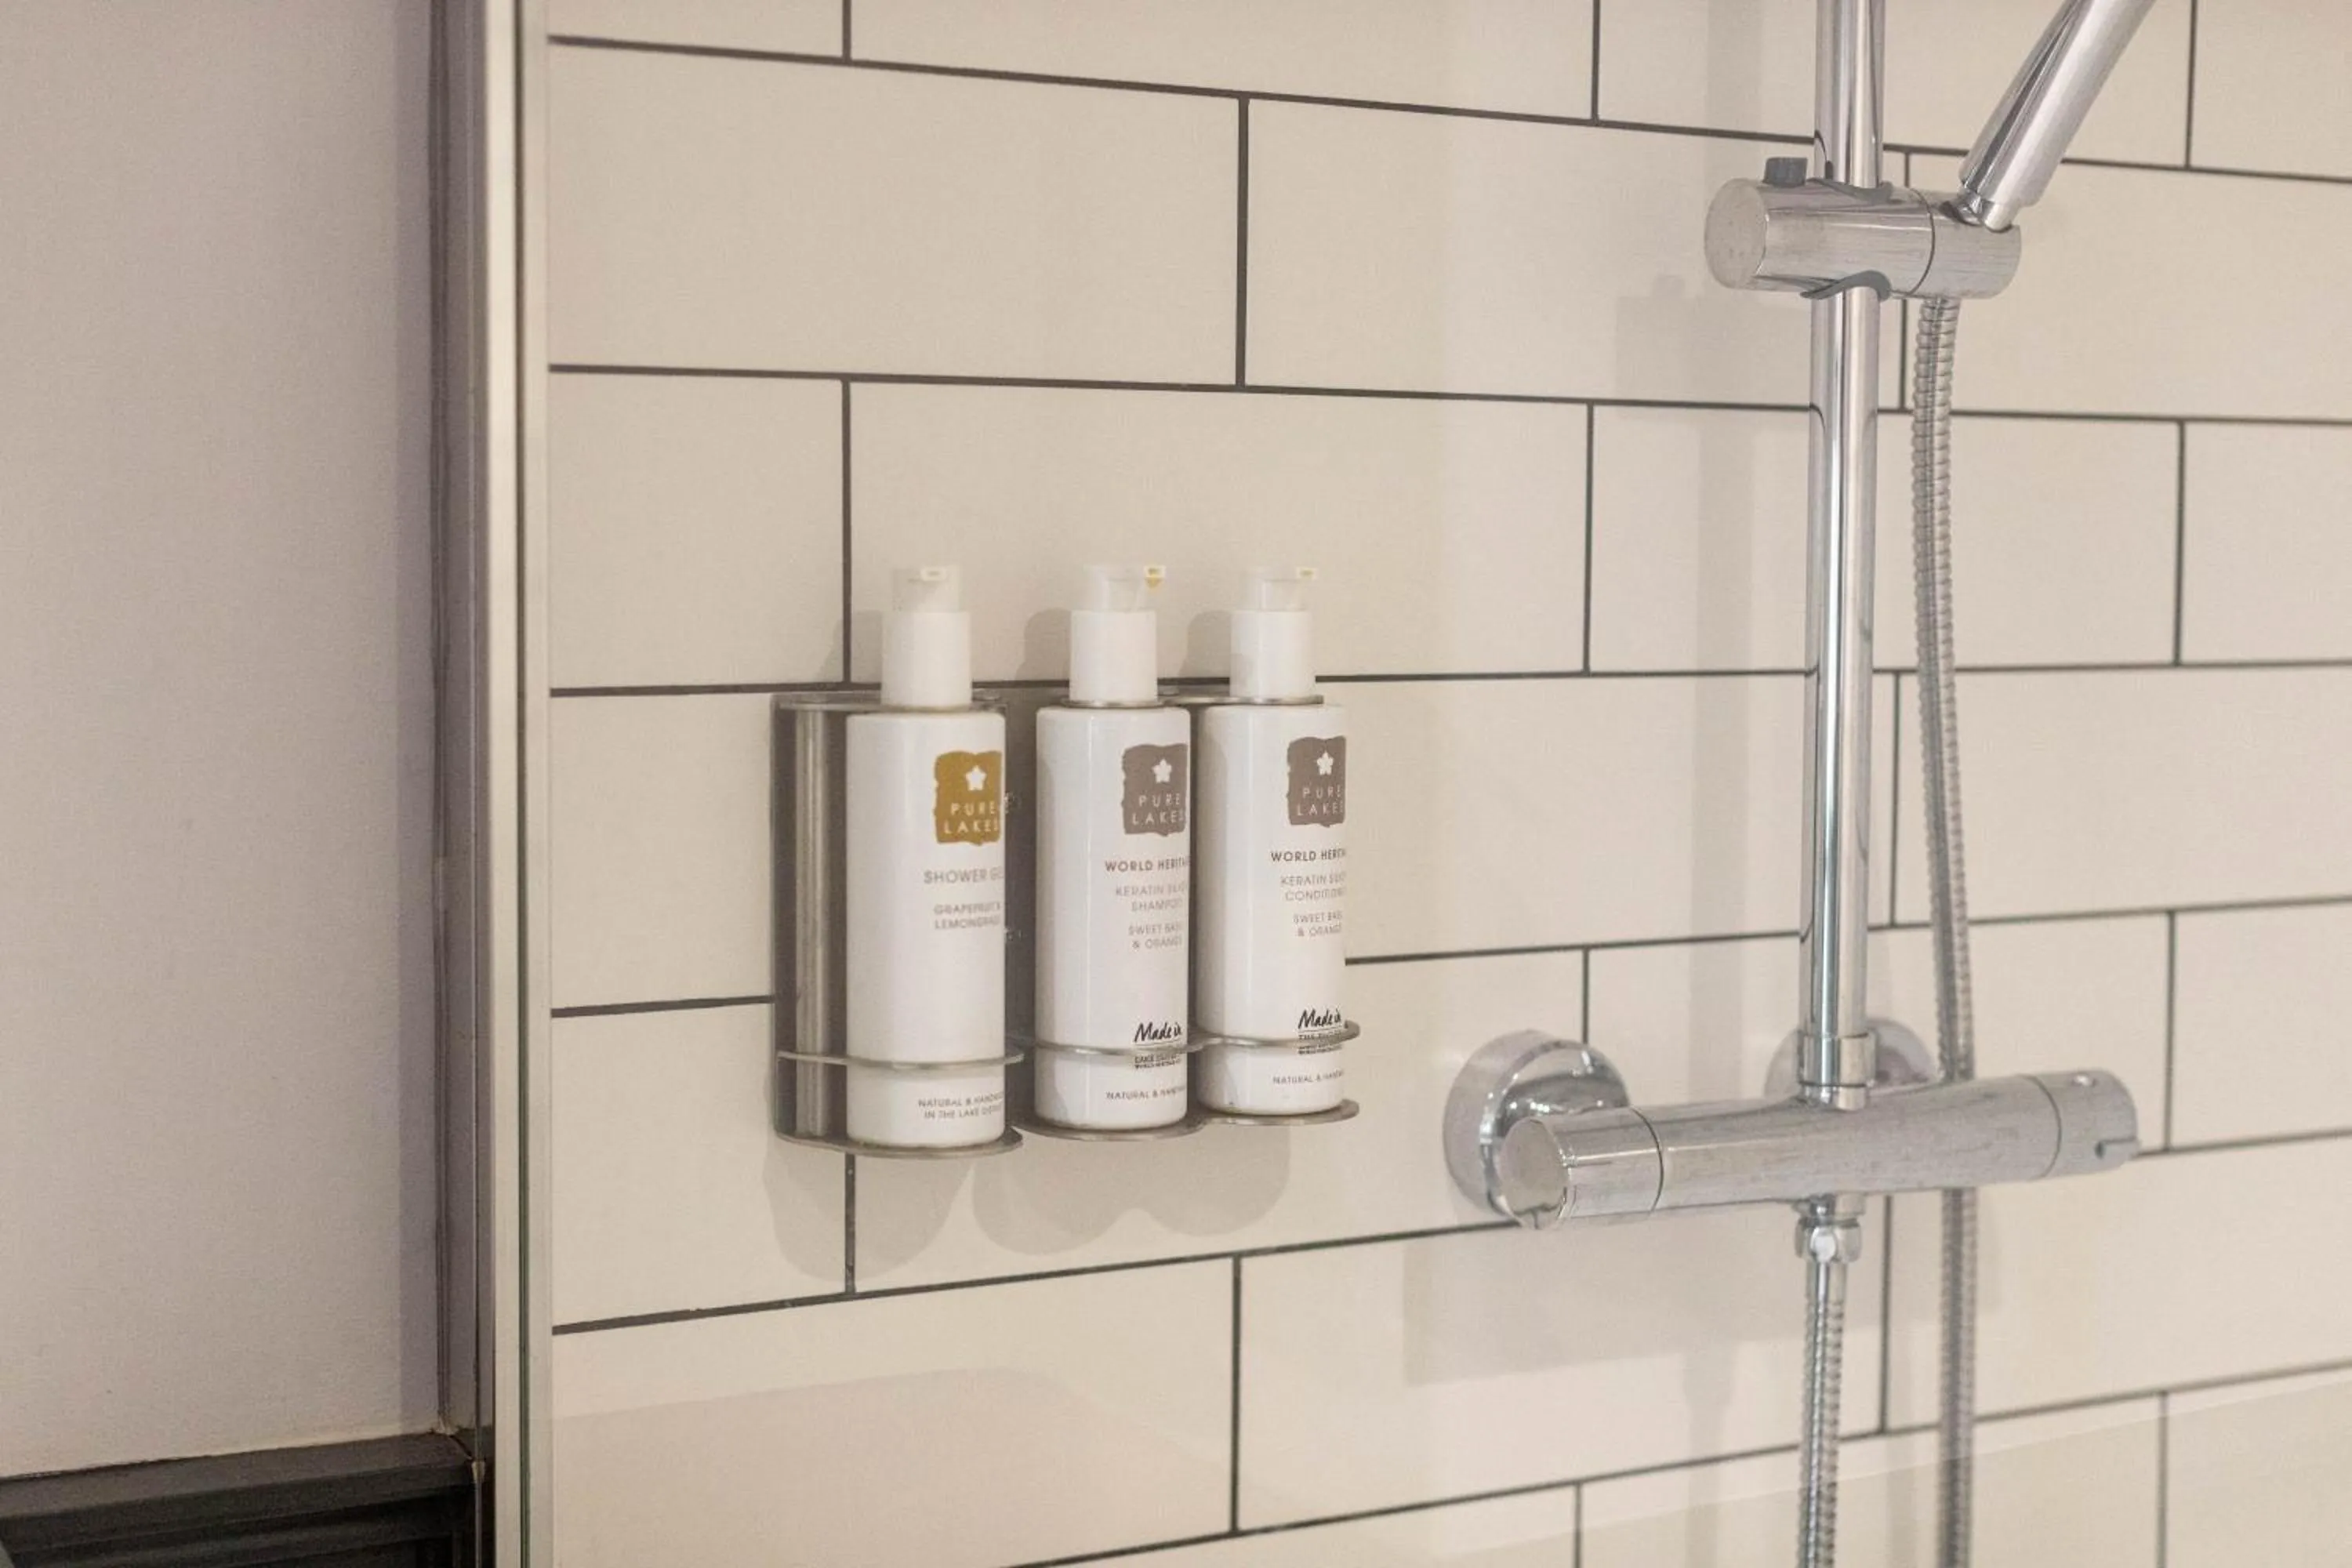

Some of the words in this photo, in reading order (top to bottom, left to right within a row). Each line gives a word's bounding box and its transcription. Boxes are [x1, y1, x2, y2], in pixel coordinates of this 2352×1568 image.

[1302, 786, 1341, 798] PURE
[1139, 793, 1180, 807] PURE
[951, 801, 996, 816] PURE
[1271, 851, 1316, 862] WORLD
[1105, 861, 1153, 872] WORLD
[924, 869, 987, 884] SHOWER
[1280, 874, 1327, 886] KERATIN
[1116, 884, 1163, 897] KERATIN
[1298, 1008, 1333, 1029] Made
[1134, 1022, 1172, 1043] Made
